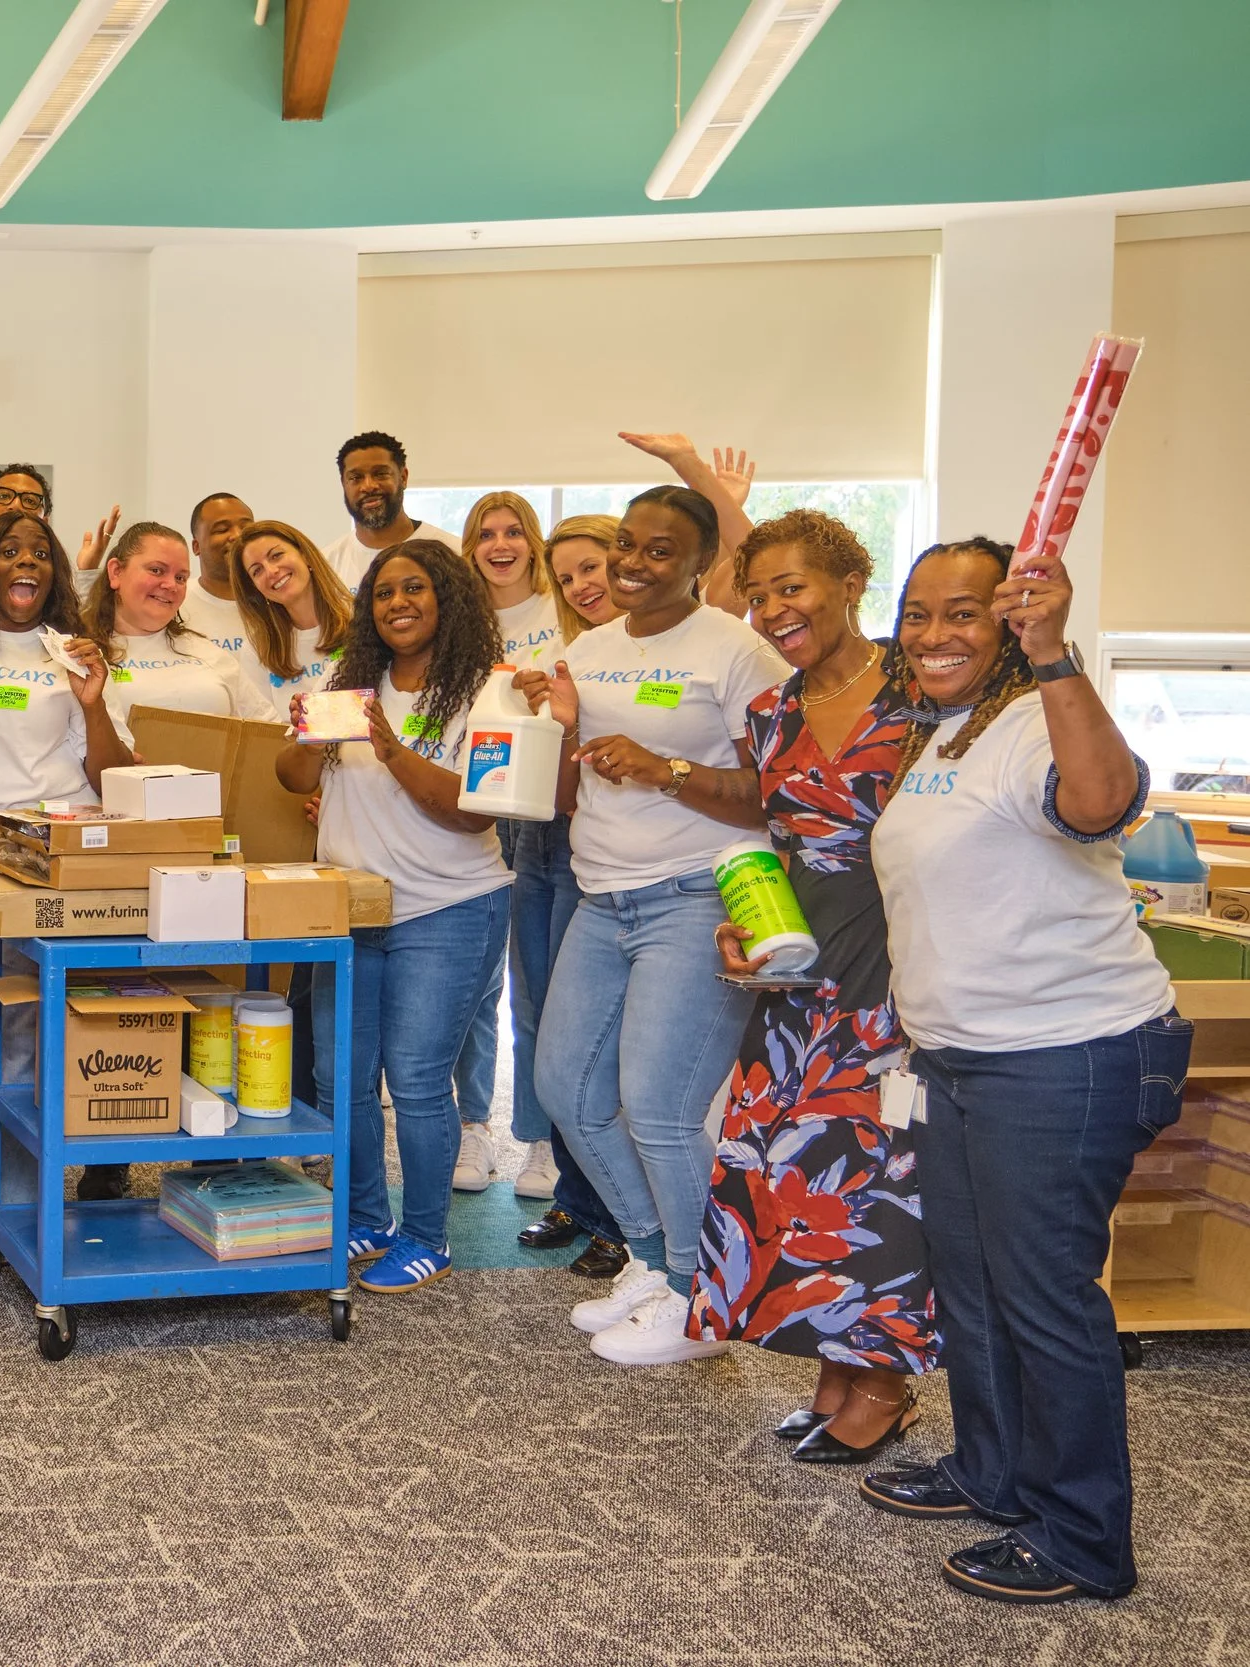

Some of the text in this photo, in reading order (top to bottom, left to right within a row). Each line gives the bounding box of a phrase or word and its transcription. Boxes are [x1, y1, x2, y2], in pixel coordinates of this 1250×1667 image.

[651, 687, 679, 695] VISITOR
[473, 751, 504, 761] Glue-All
[118, 1013, 175, 1028] 55971 02
[78, 1050, 163, 1081] Kleenex
[94, 1083, 120, 1092] Ultra
